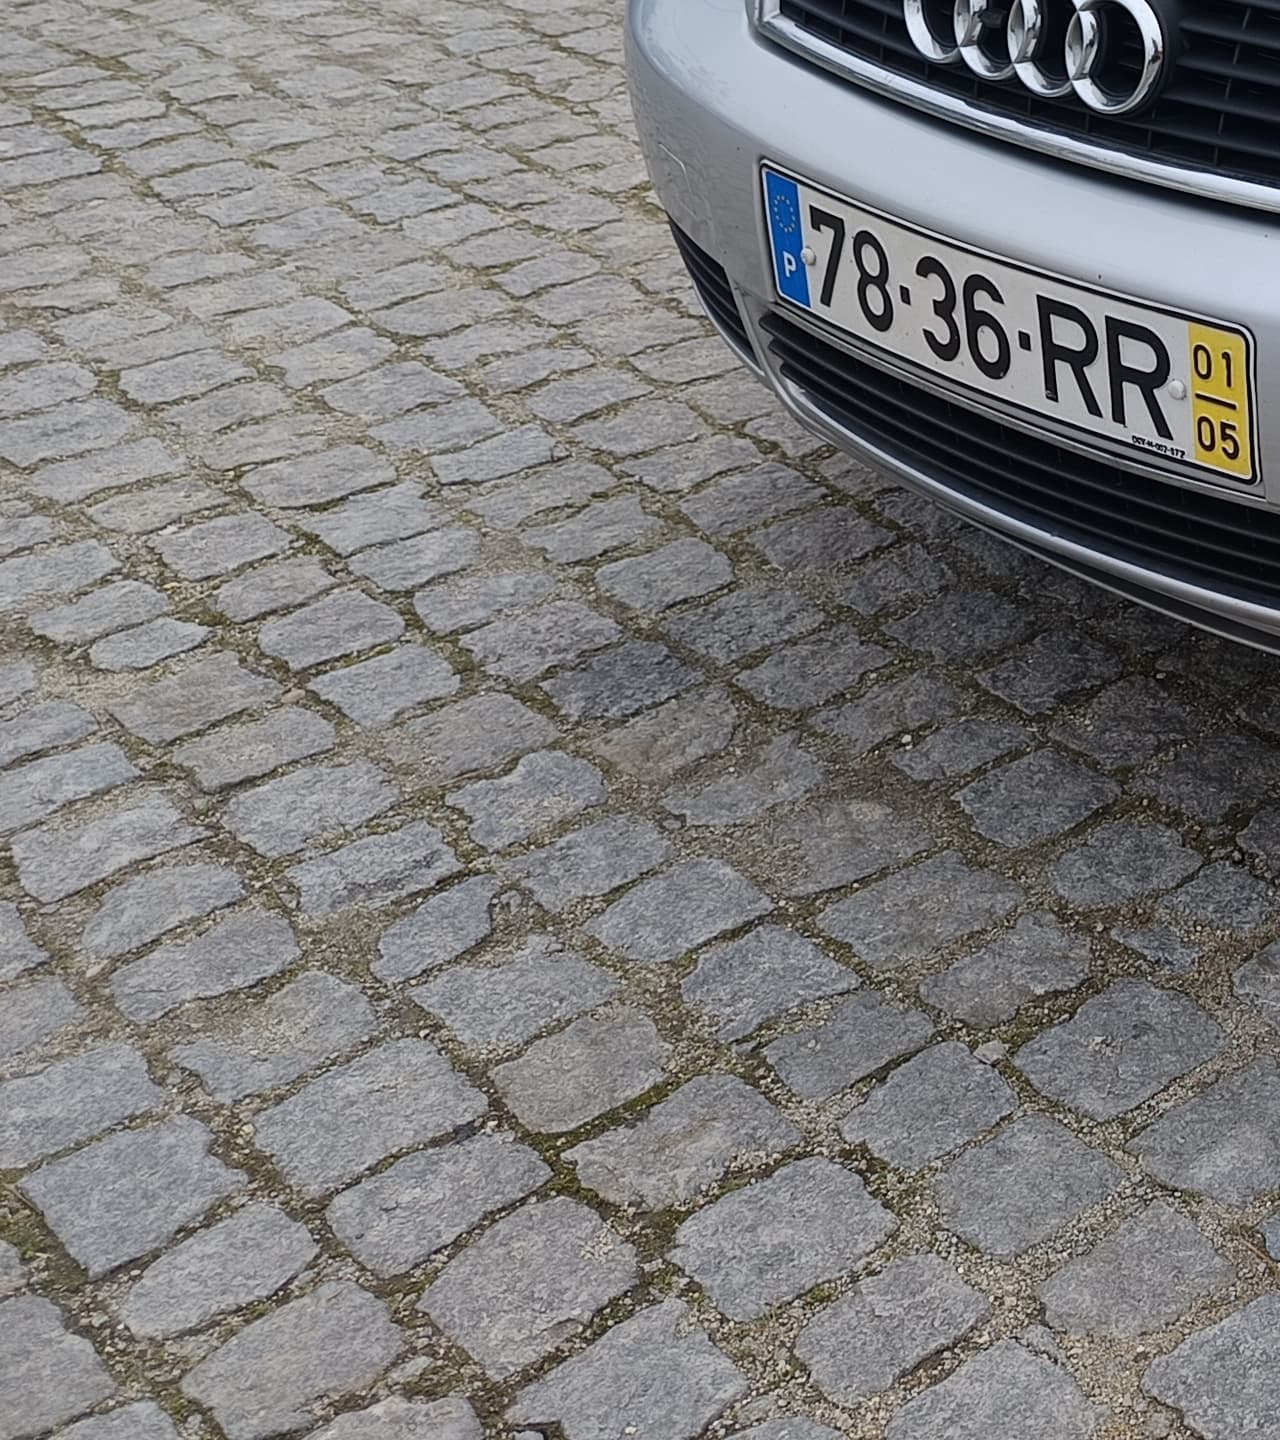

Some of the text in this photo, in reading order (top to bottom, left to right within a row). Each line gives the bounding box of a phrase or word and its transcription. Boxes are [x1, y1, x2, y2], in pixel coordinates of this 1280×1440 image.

[782, 250, 798, 279] P
[1193, 343, 1234, 389] 01
[1195, 415, 1241, 461] 05
